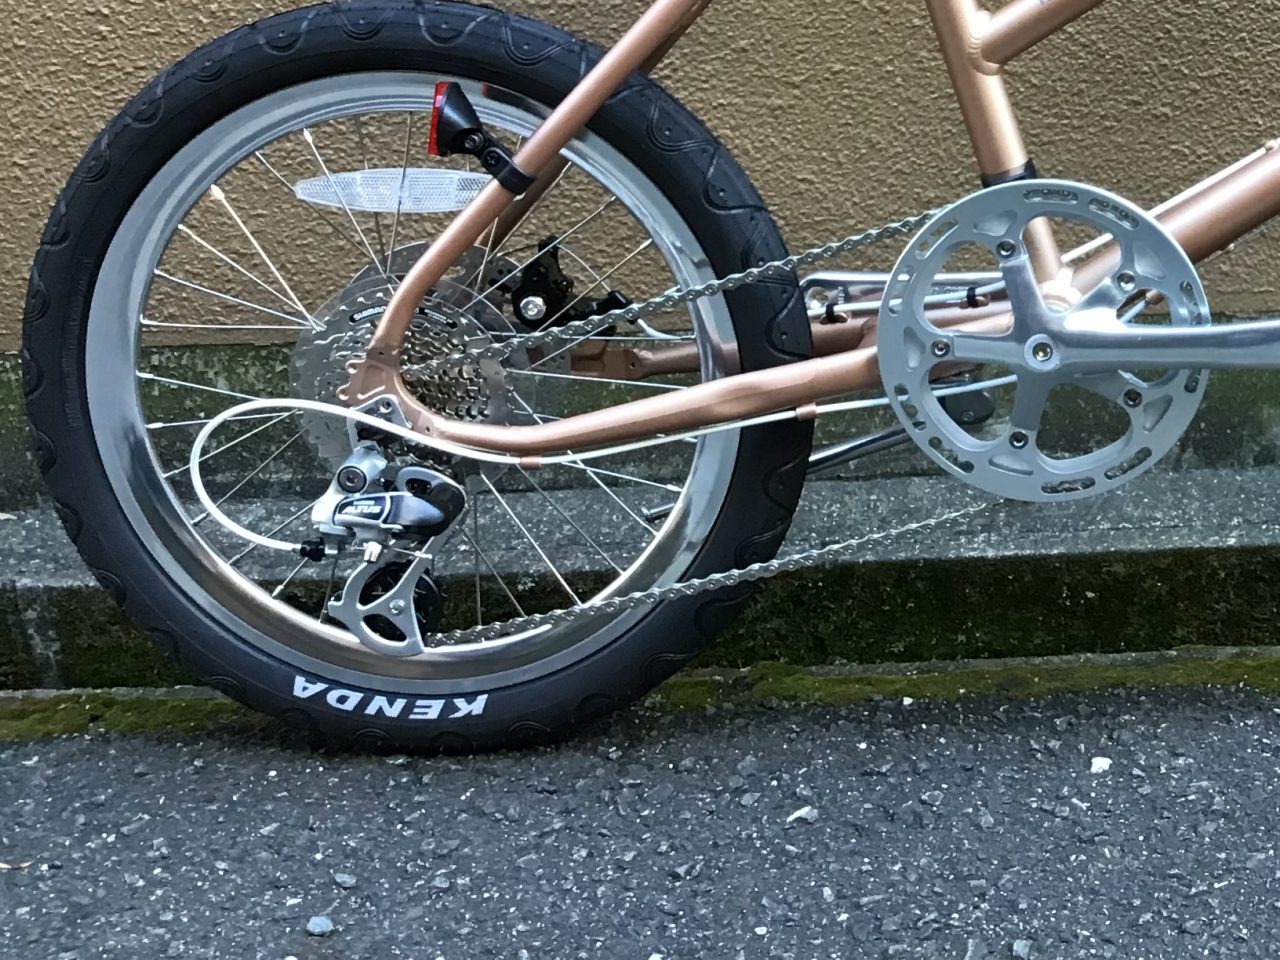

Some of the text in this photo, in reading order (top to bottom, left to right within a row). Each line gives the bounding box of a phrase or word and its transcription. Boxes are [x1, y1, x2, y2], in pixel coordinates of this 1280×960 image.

[353, 305, 387, 320] SHIMAN
[341, 505, 382, 514] ALTUS
[292, 675, 489, 720] KENDA
